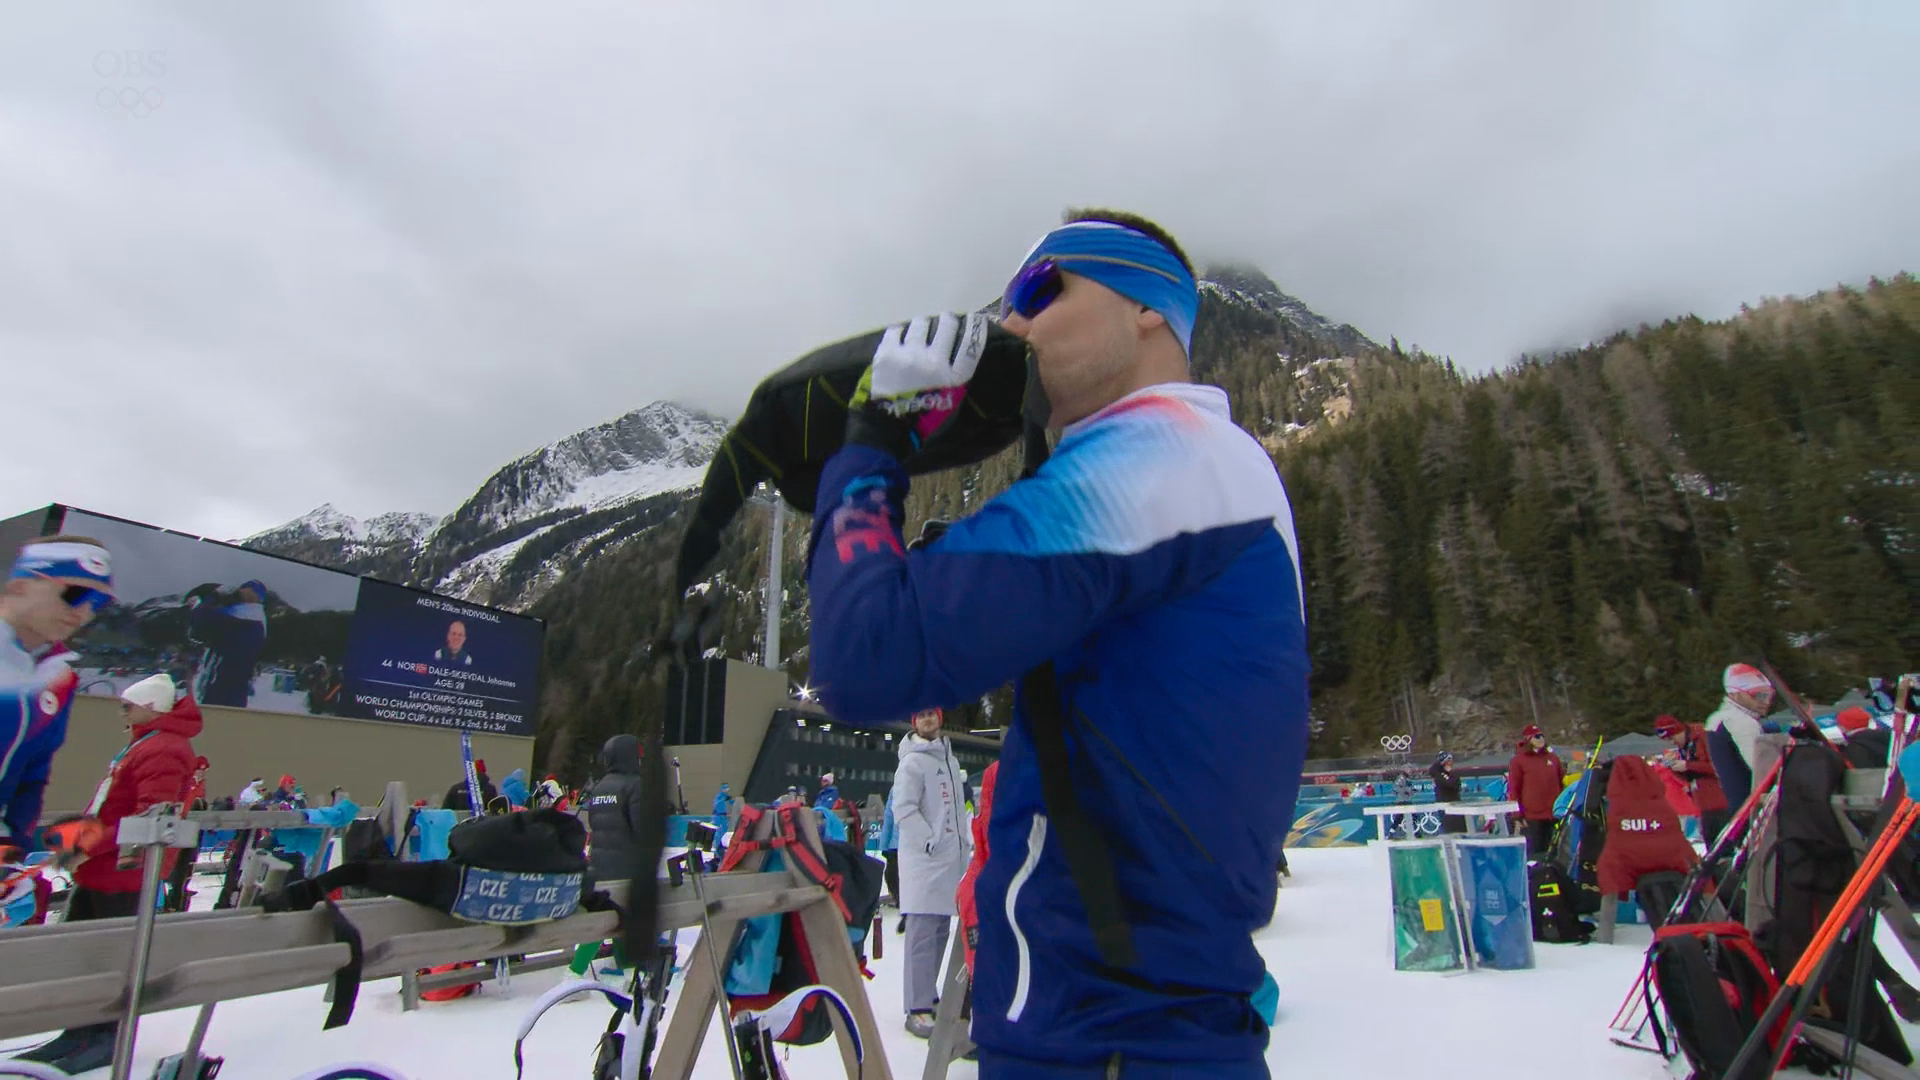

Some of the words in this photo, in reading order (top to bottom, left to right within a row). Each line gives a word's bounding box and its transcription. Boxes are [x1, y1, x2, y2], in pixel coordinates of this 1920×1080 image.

[416, 597, 440, 609] MEN'S
[441, 602, 460, 614] 20km
[460, 607, 500, 623] INDIVIDUAL
[381, 659, 393, 667] 44
[397, 661, 416, 672] NOR
[486, 676, 516, 688] Johannes
[356, 694, 389, 707] WORLD
[495, 712, 523, 723] BRONZE
[408, 690, 420, 699] 1st
[421, 691, 456, 705] OLYMPIC
[457, 697, 484, 708] GAMES
[375, 708, 406, 720] WORLD
[494, 722, 507, 731] 3rd
[1313, 775, 1337, 785] STOP
[1620, 818, 1647, 831] SUI
[479, 878, 510, 899] CZE
[534, 887, 559, 904] CZE
[486, 903, 525, 921] CZE
